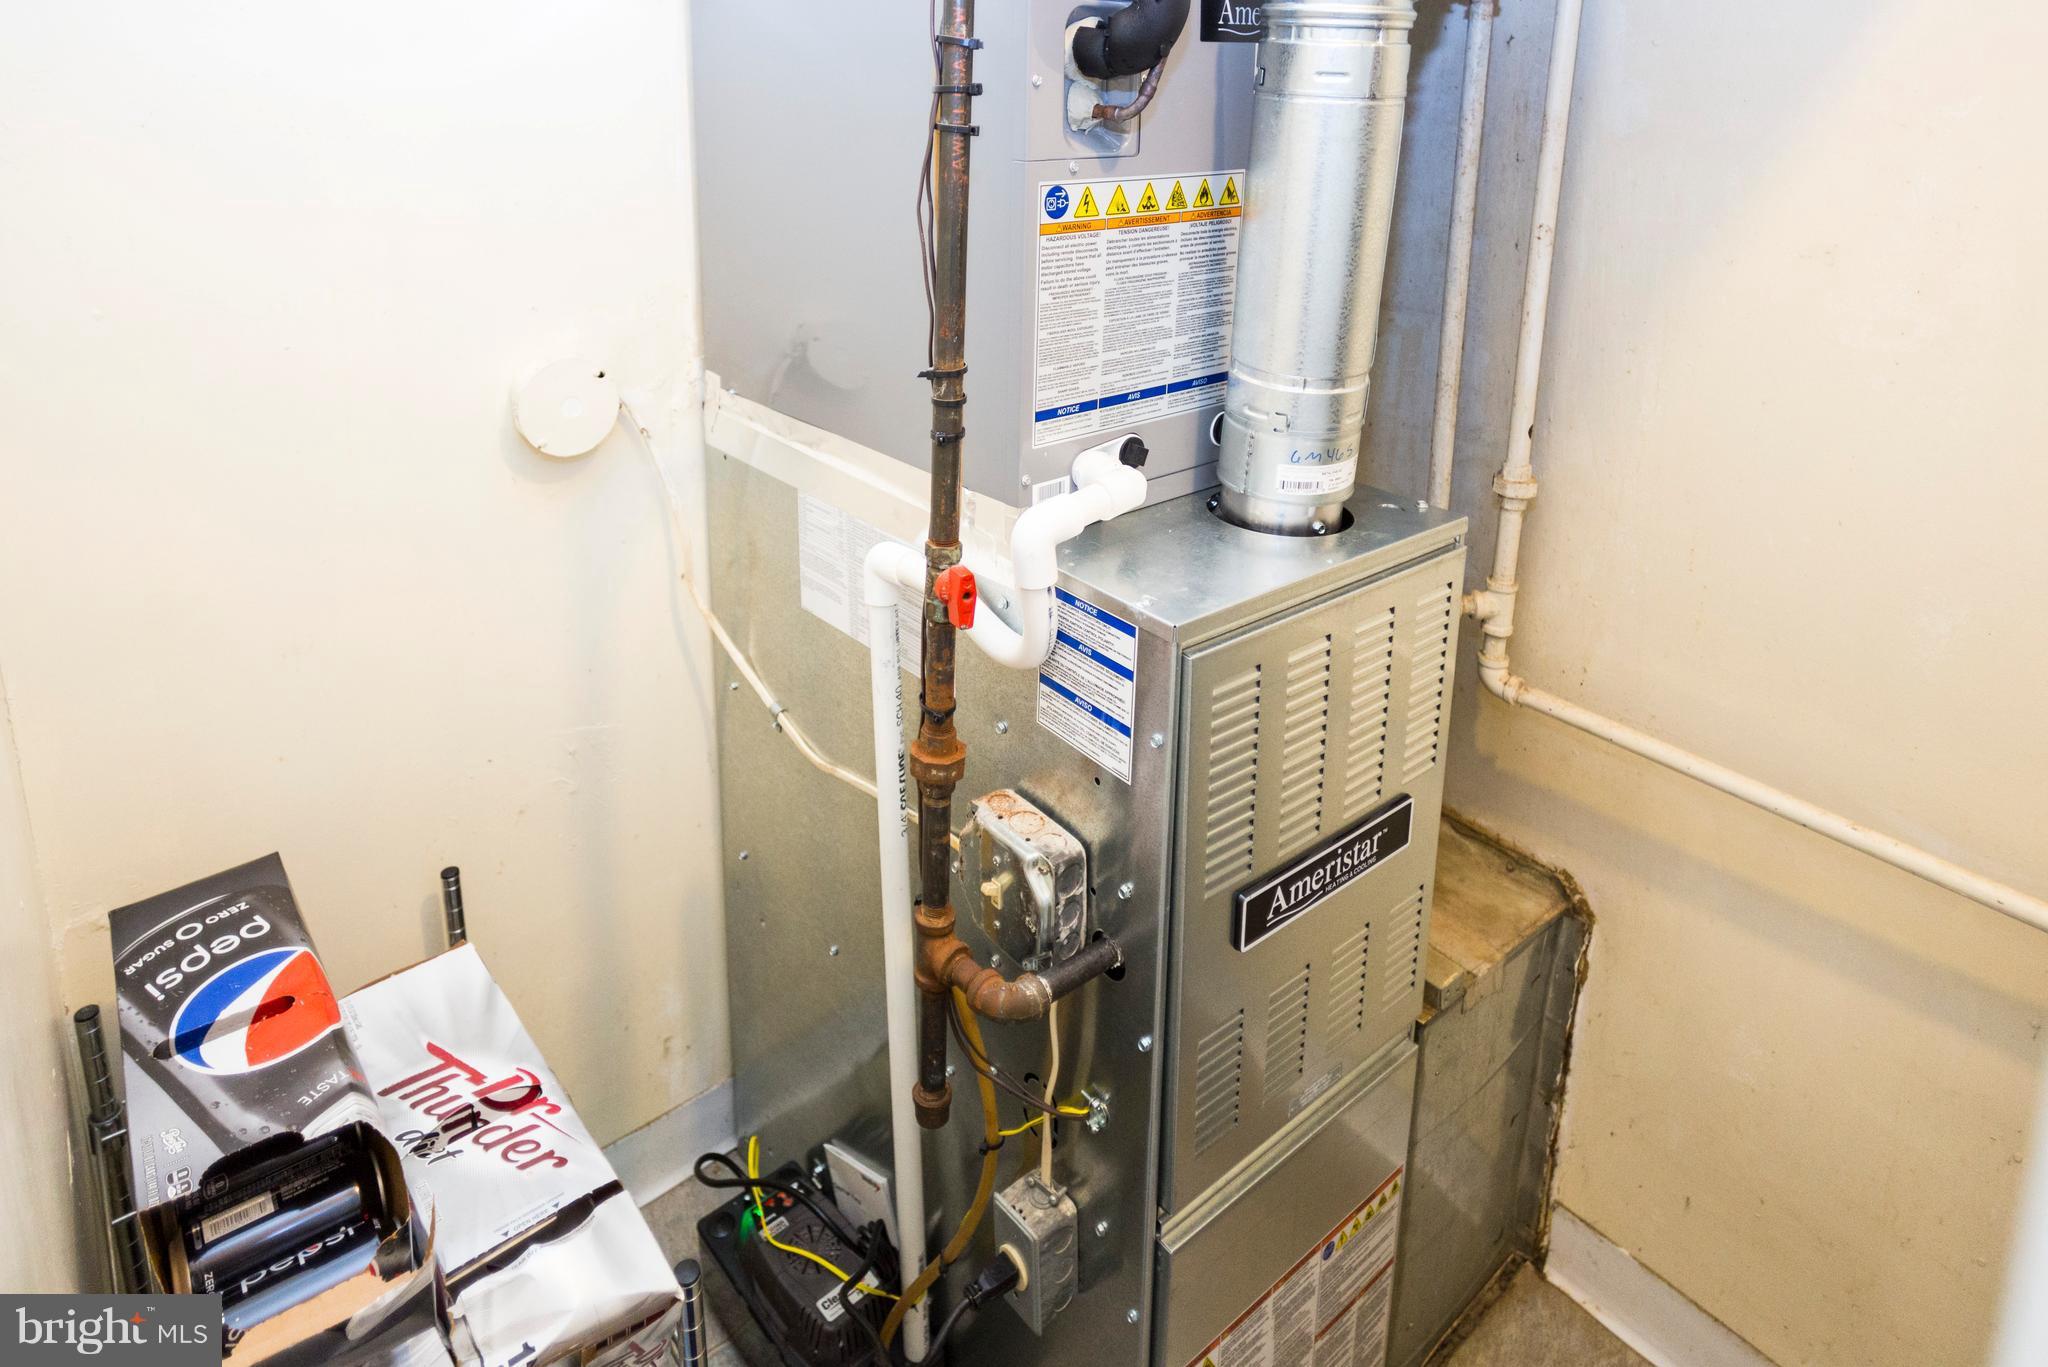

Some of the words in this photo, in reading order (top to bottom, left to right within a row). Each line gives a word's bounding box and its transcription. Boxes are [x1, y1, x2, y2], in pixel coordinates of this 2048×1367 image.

[1125, 216, 1170, 225] AVERTISSEMENT
[1197, 210, 1231, 218] ADVERTENCIA
[1192, 377, 1208, 386] AVISO
[1128, 392, 1140, 400] AVIS
[1057, 405, 1079, 415] NOTICE
[1075, 600, 1098, 616] NOTICE
[1078, 644, 1092, 655] AVIS
[1075, 697, 1092, 711] AVISO
[1267, 831, 1382, 920] Ameristar
[1325, 873, 1350, 892] HEATING
[1354, 856, 1376, 875] COOLING
[206, 902, 250, 924] ZERO
[124, 939, 175, 976] SUGAR
[144, 915, 271, 1001] pepsi
[377, 1041, 568, 1170] Thunder
[241, 1226, 355, 1294] pepsi
